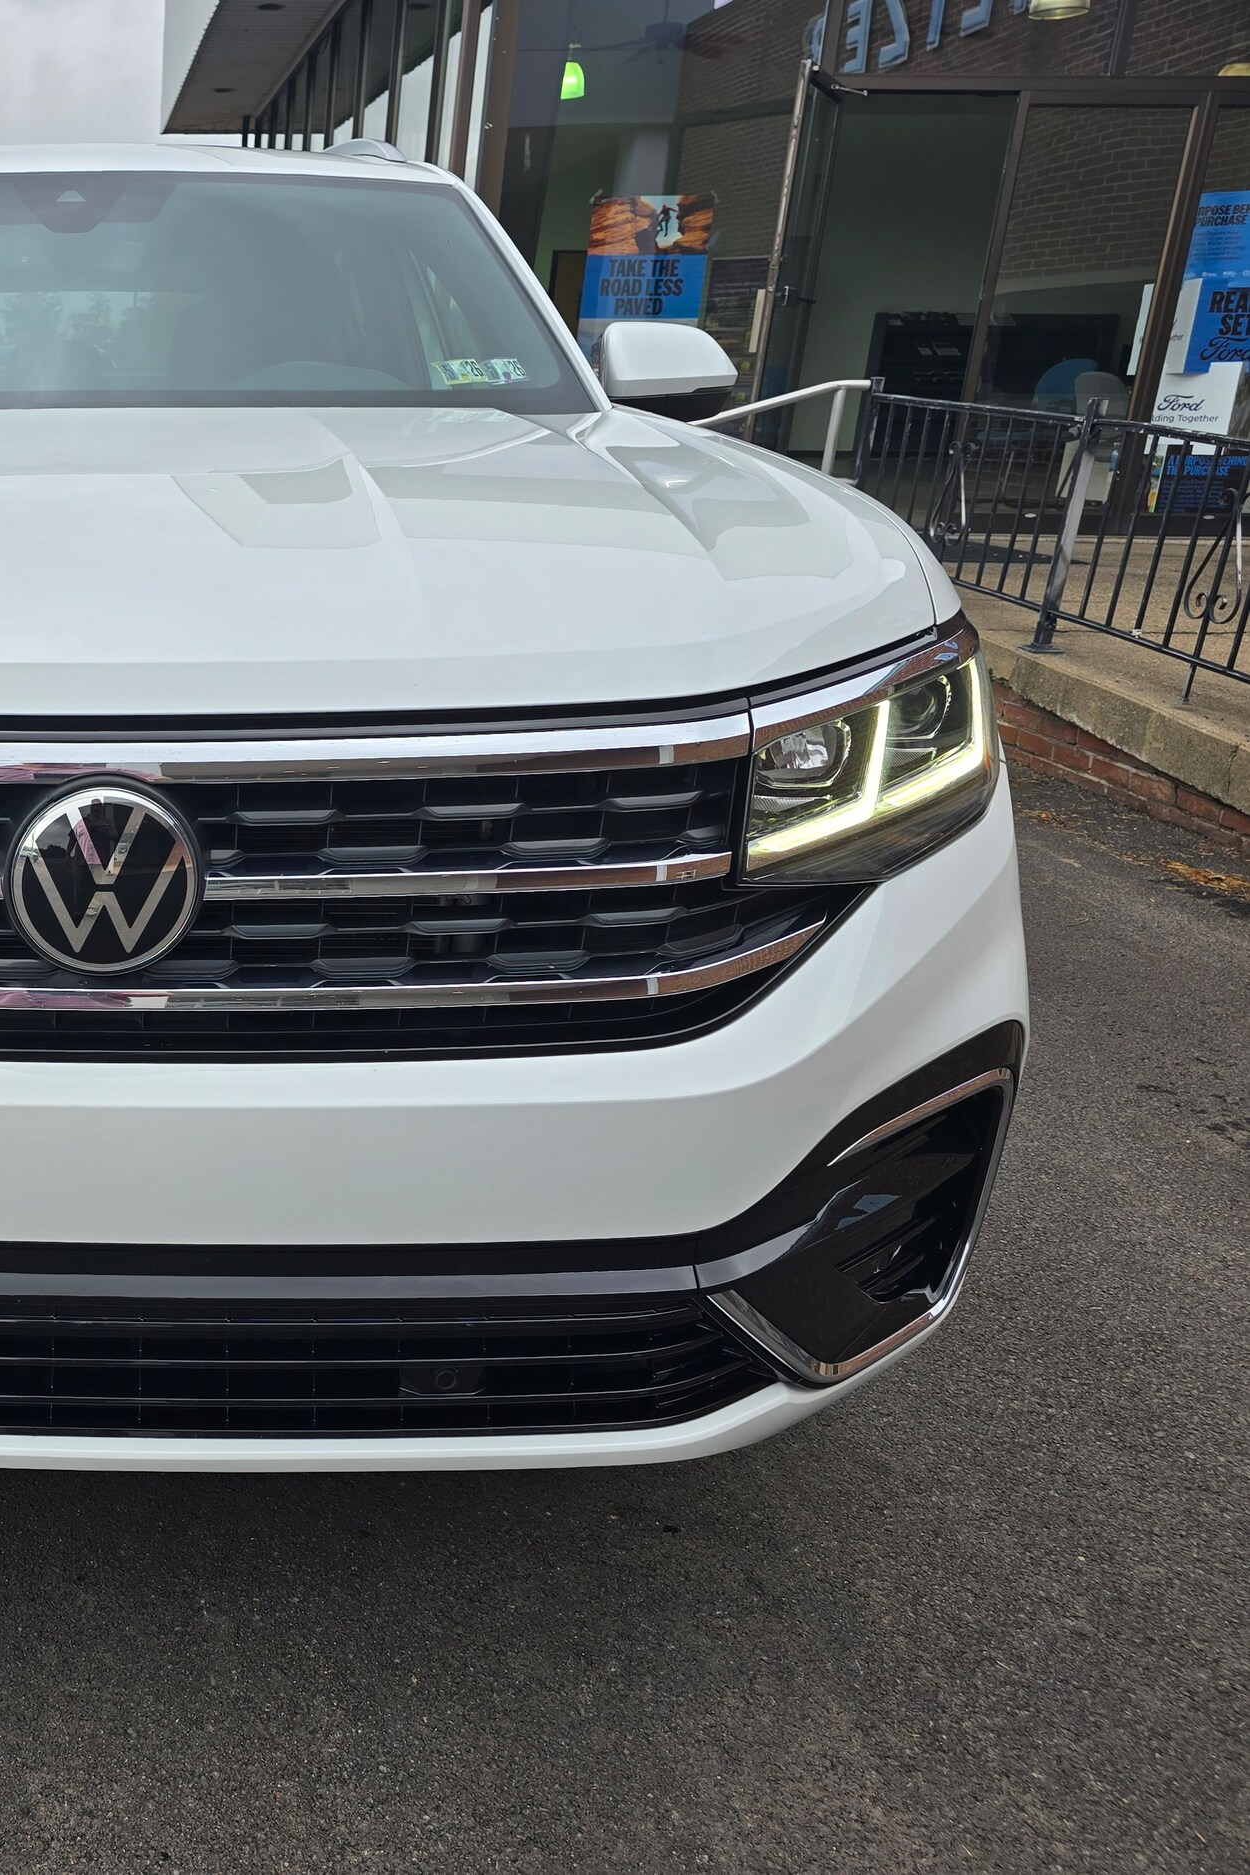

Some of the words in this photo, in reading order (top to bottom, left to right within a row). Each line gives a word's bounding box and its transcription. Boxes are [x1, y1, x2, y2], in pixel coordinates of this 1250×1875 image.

[1198, 204, 1231, 217] RPOSE
[609, 259, 646, 277] TAKE
[651, 259, 680, 277] THE
[600, 278, 643, 296] ROAD
[645, 278, 684, 297] LESS
[614, 298, 664, 315] PAVED
[1209, 290, 1250, 314] REA
[465, 360, 484, 377] 26
[1157, 394, 1205, 412] Ford
[1177, 414, 1219, 423] Together
[21, 797, 189, 955] VW
